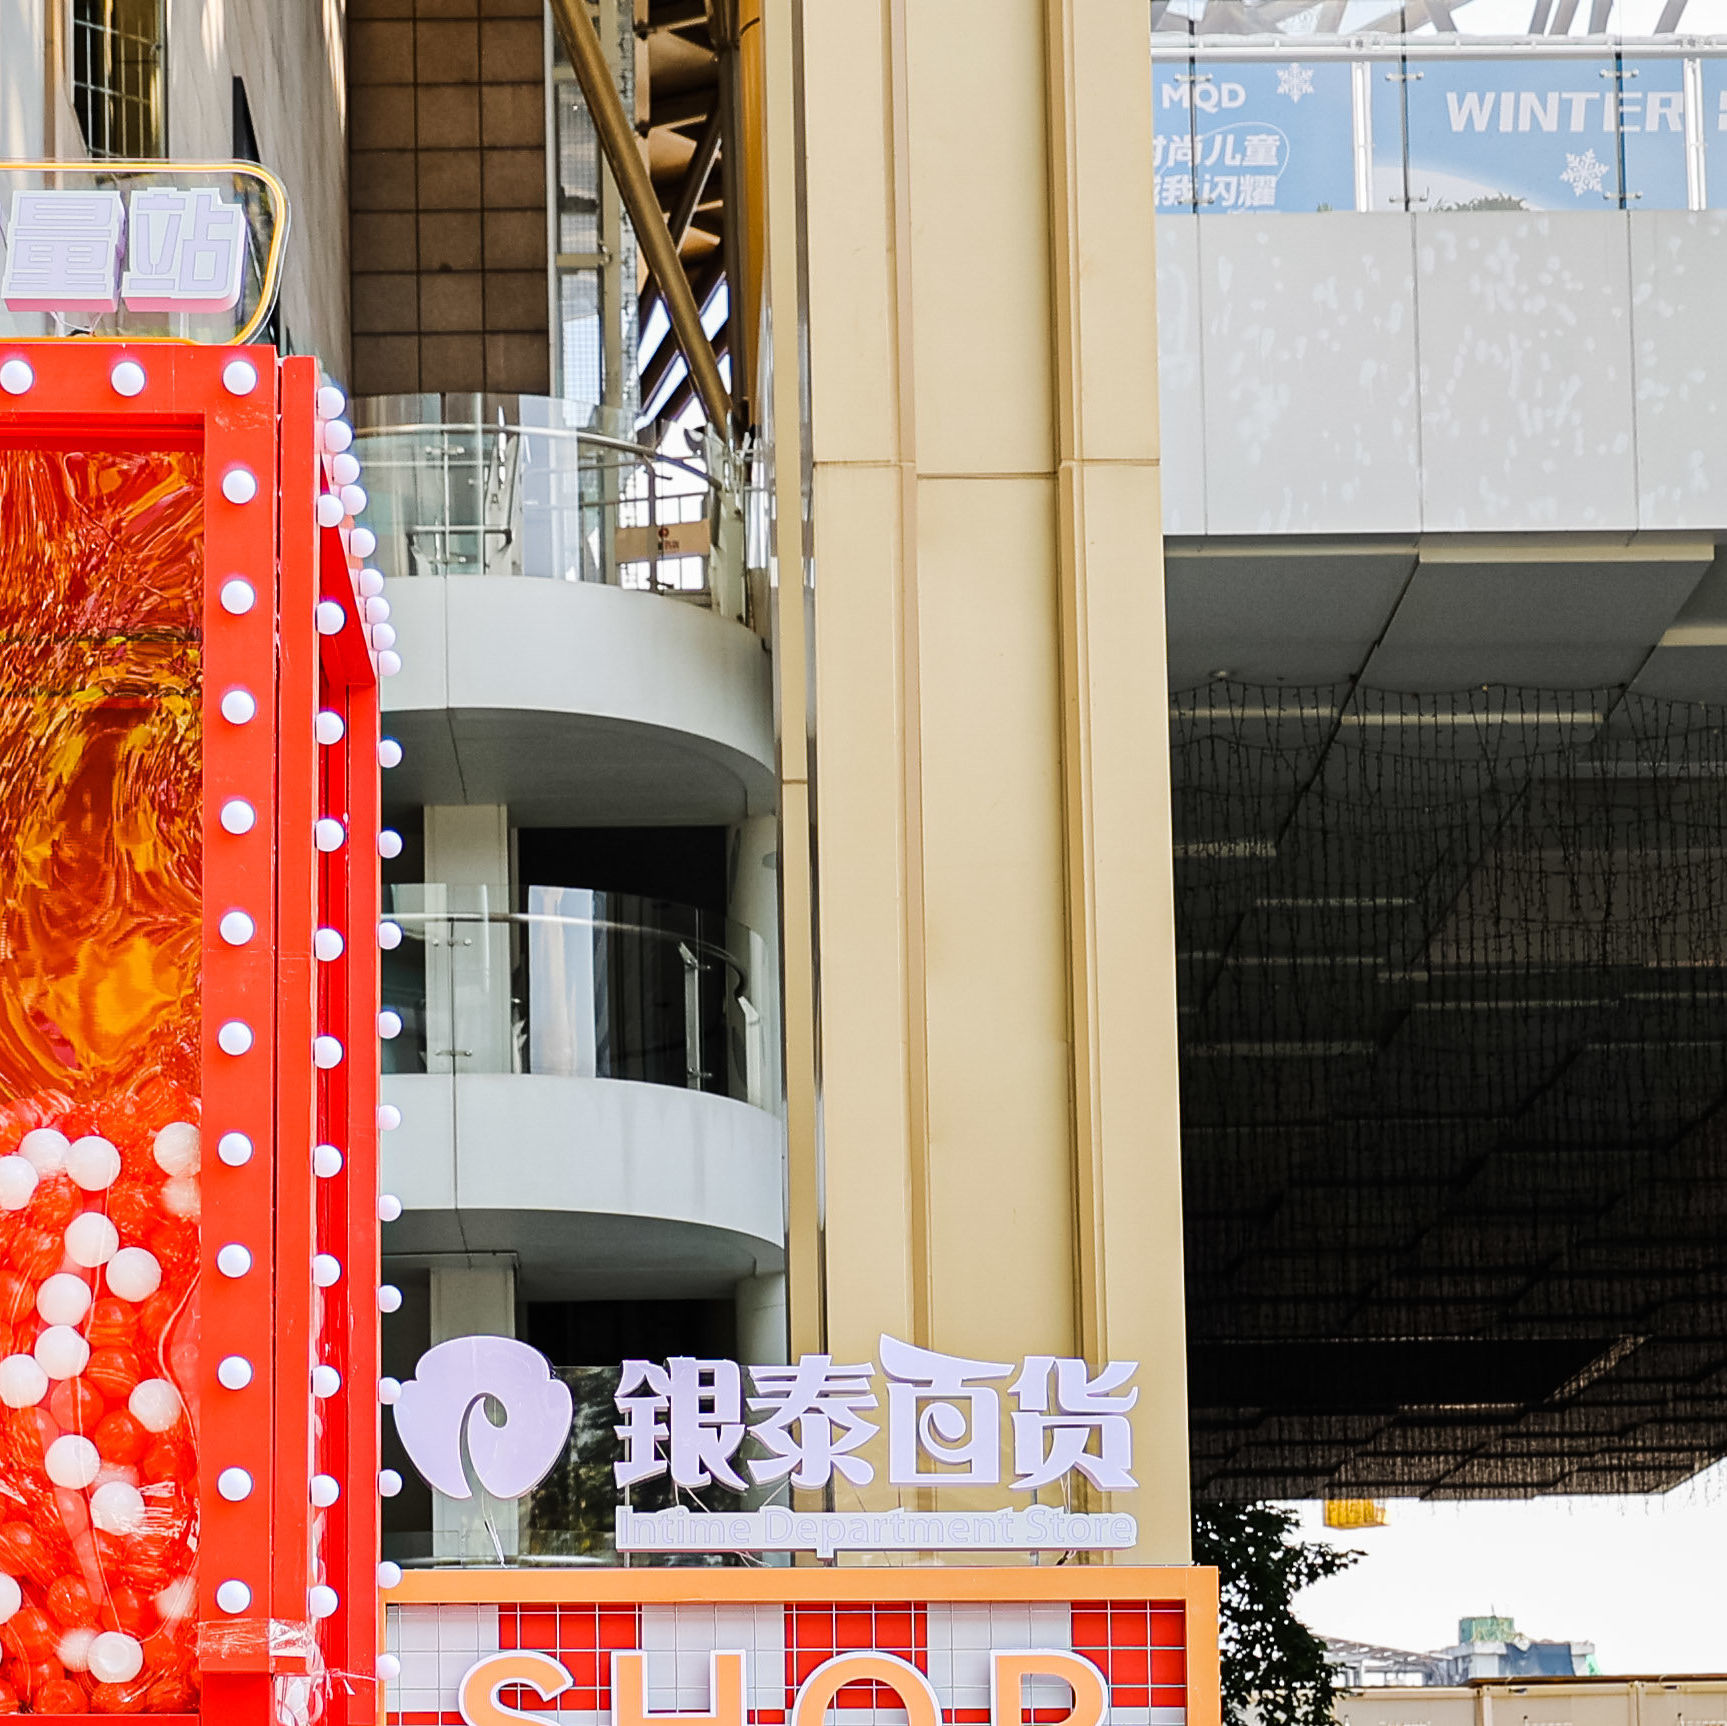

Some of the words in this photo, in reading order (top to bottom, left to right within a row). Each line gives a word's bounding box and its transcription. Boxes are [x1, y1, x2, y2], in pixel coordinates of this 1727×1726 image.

[1162, 82, 1246, 113] MQD
[1446, 91, 1682, 132] WINTER
[1153, 174, 1278, 207] 我闪耀
[613, 1334, 1141, 1493] 银泰百货
[618, 1505, 753, 1545] Intime
[764, 1508, 1017, 1554] Department
[1026, 1509, 1137, 1545] Store
